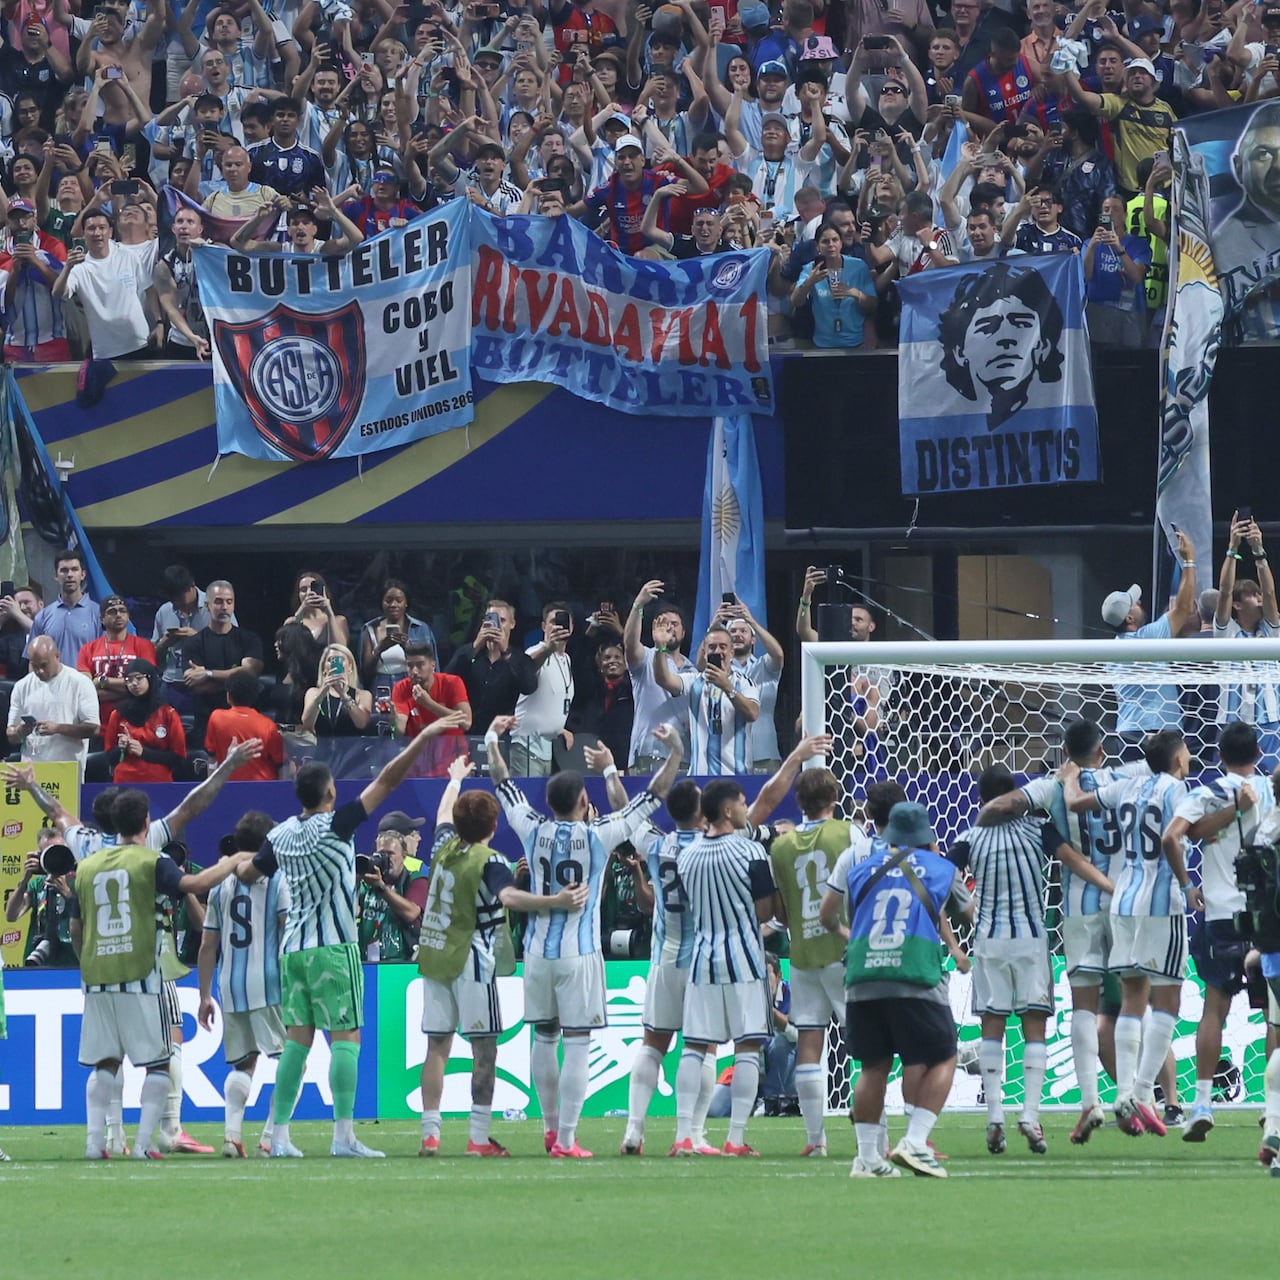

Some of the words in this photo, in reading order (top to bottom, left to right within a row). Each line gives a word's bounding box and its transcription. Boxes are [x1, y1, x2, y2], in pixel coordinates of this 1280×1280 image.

[227, 218, 450, 298] BUTTELER
[382, 282, 456, 337] COBO
[471, 244, 727, 370] RIVADAVIA
[394, 348, 460, 397] VIEL
[472, 334, 751, 412] BUTTELER
[360, 411, 410, 440] ESTADOS
[409, 402, 452, 430] UNIDOS
[41, 783, 61, 792] FAN
[1077, 808, 1124, 858] 13
[1121, 803, 1162, 860] 26
[2, 855, 21, 865] FAN
[538, 856, 583, 898] 19
[229, 894, 253, 949] 9
[96, 943, 134, 956] 2026
[863, 956, 904, 969] 2026
